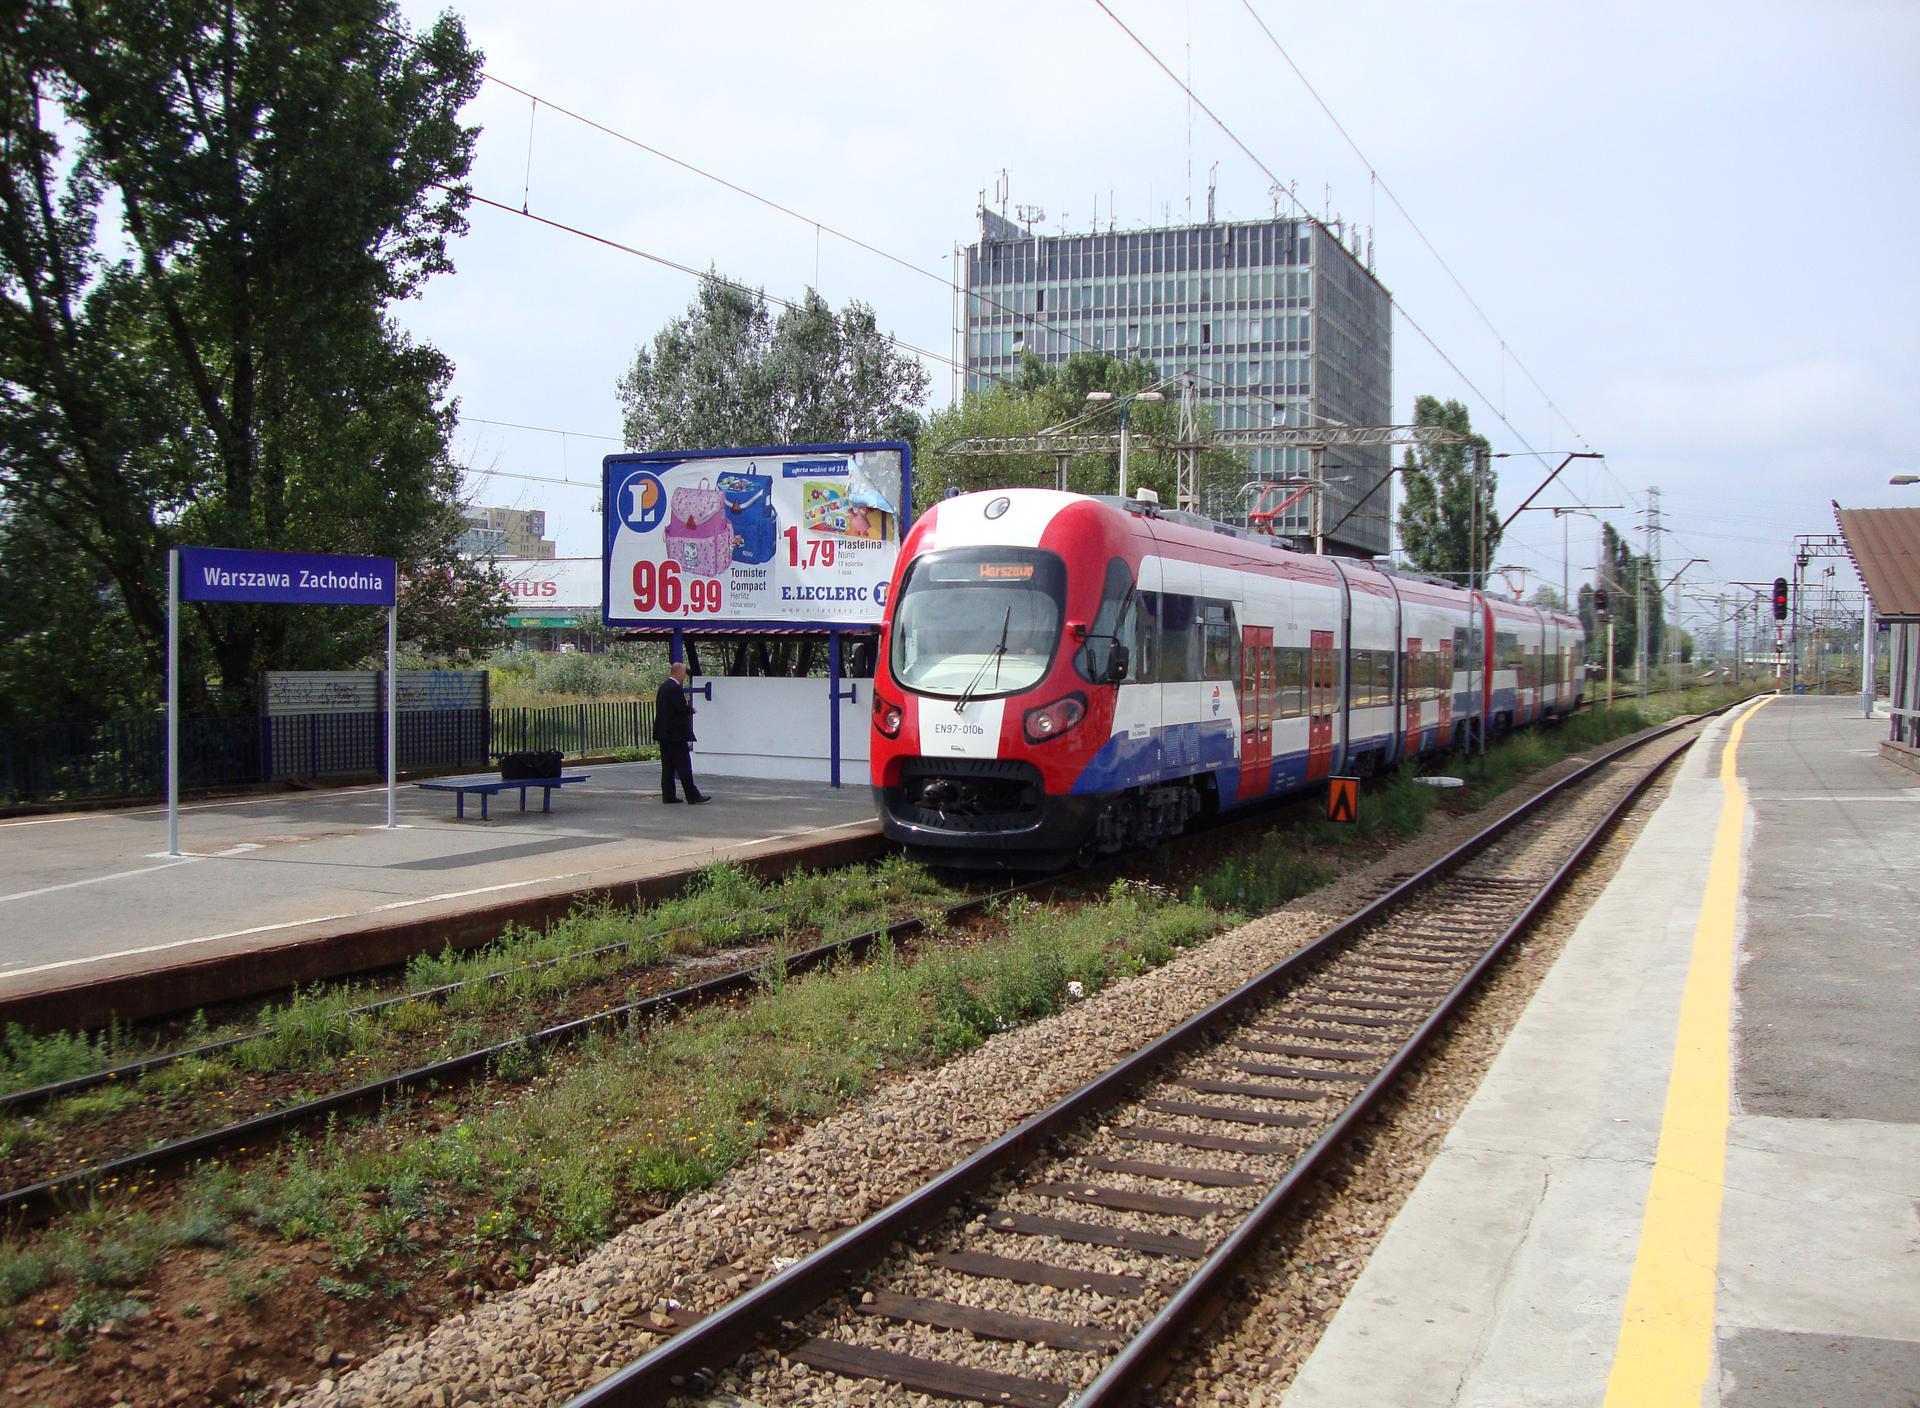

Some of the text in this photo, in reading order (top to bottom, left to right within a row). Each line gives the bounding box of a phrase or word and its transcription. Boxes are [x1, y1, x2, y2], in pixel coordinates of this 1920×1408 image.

[783, 526, 835, 570] 1,79
[838, 540, 882, 550] Plastelina
[203, 567, 383, 590] Warszawa Zachodnia
[730, 567, 767, 578] Tornister
[632, 560, 722, 616] 96,99
[730, 581, 767, 592] Compact
[730, 591, 750, 600] Herlitz
[781, 586, 868, 601] E.LECLERC
[935, 723, 984, 735] EN97-010b
